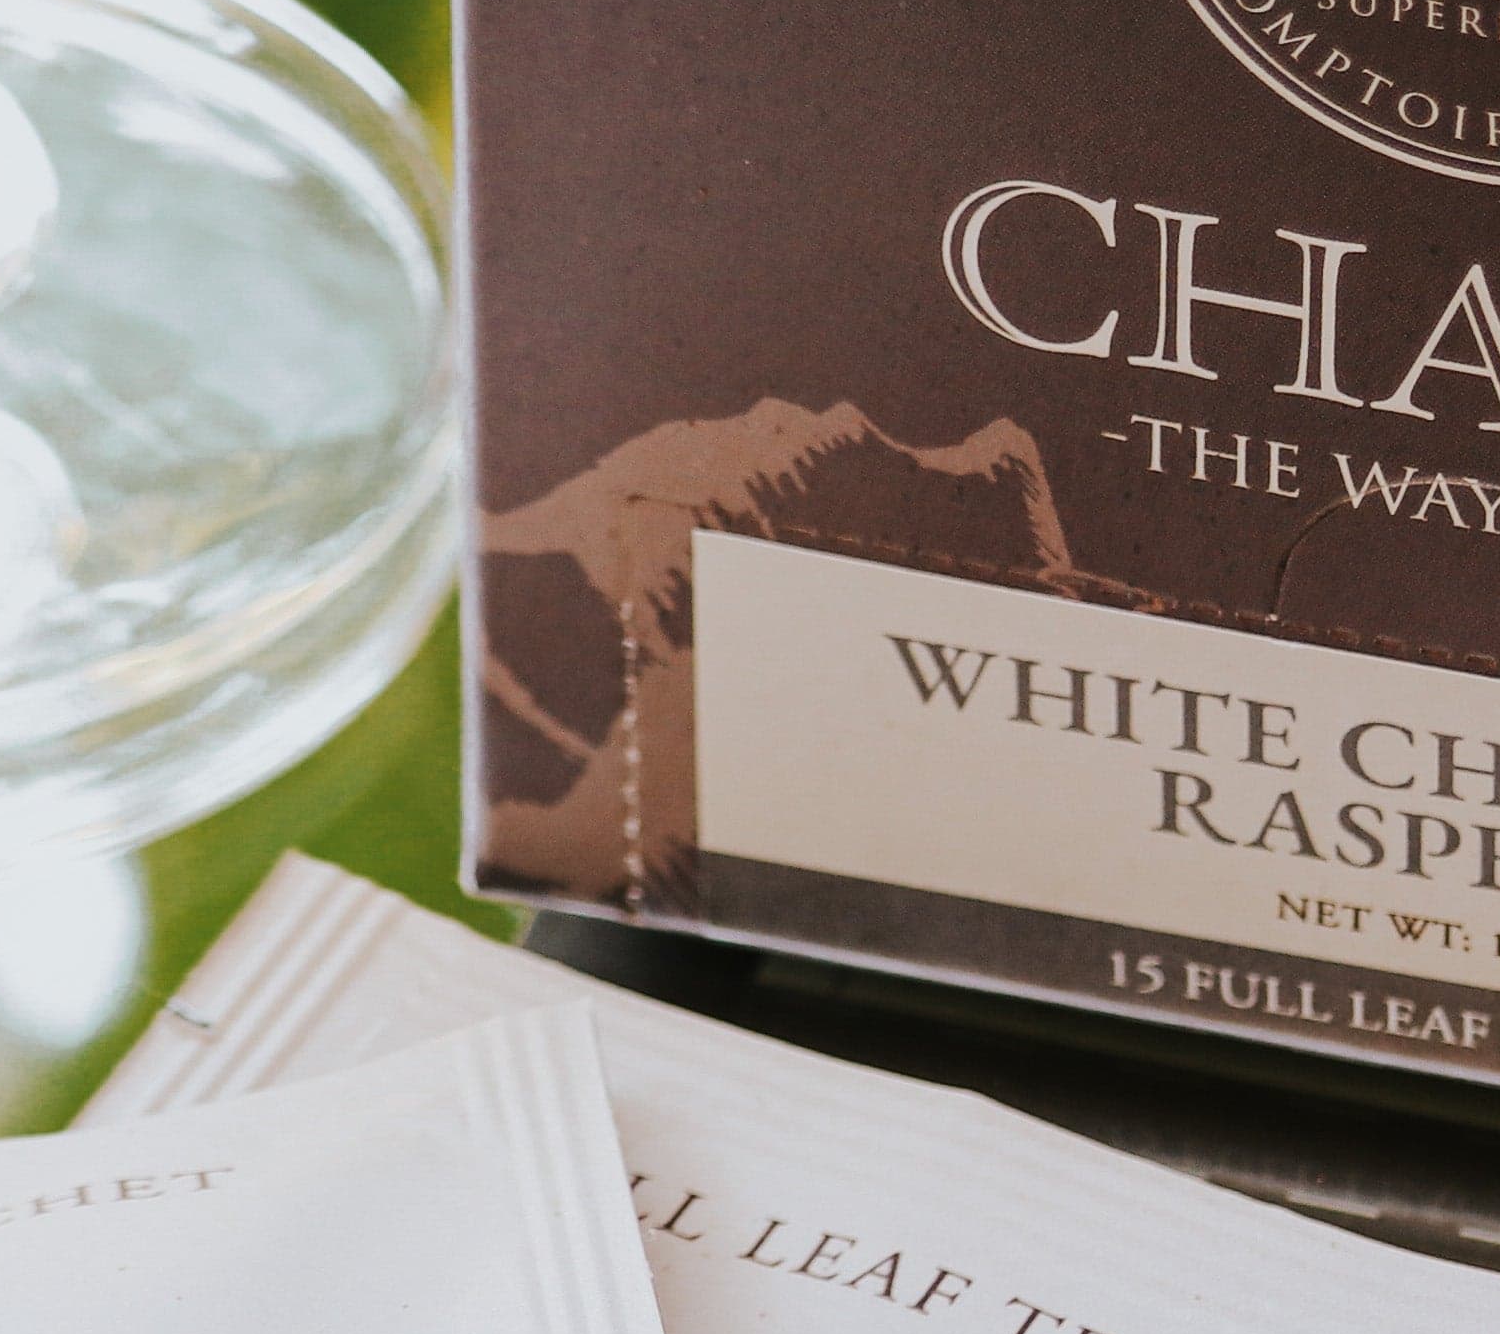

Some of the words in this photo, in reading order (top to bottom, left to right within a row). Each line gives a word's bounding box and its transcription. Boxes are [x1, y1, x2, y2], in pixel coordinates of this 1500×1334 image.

[884, 633, 1300, 775] WHITE
[1275, 893, 1370, 935] NET
[1388, 914, 1471, 954] WT:
[1108, 950, 1165, 995] 15
[1184, 962, 1331, 1023] FULL
[1349, 991, 1491, 1049] LEAF
[738, 1218, 974, 1315] LEAF
